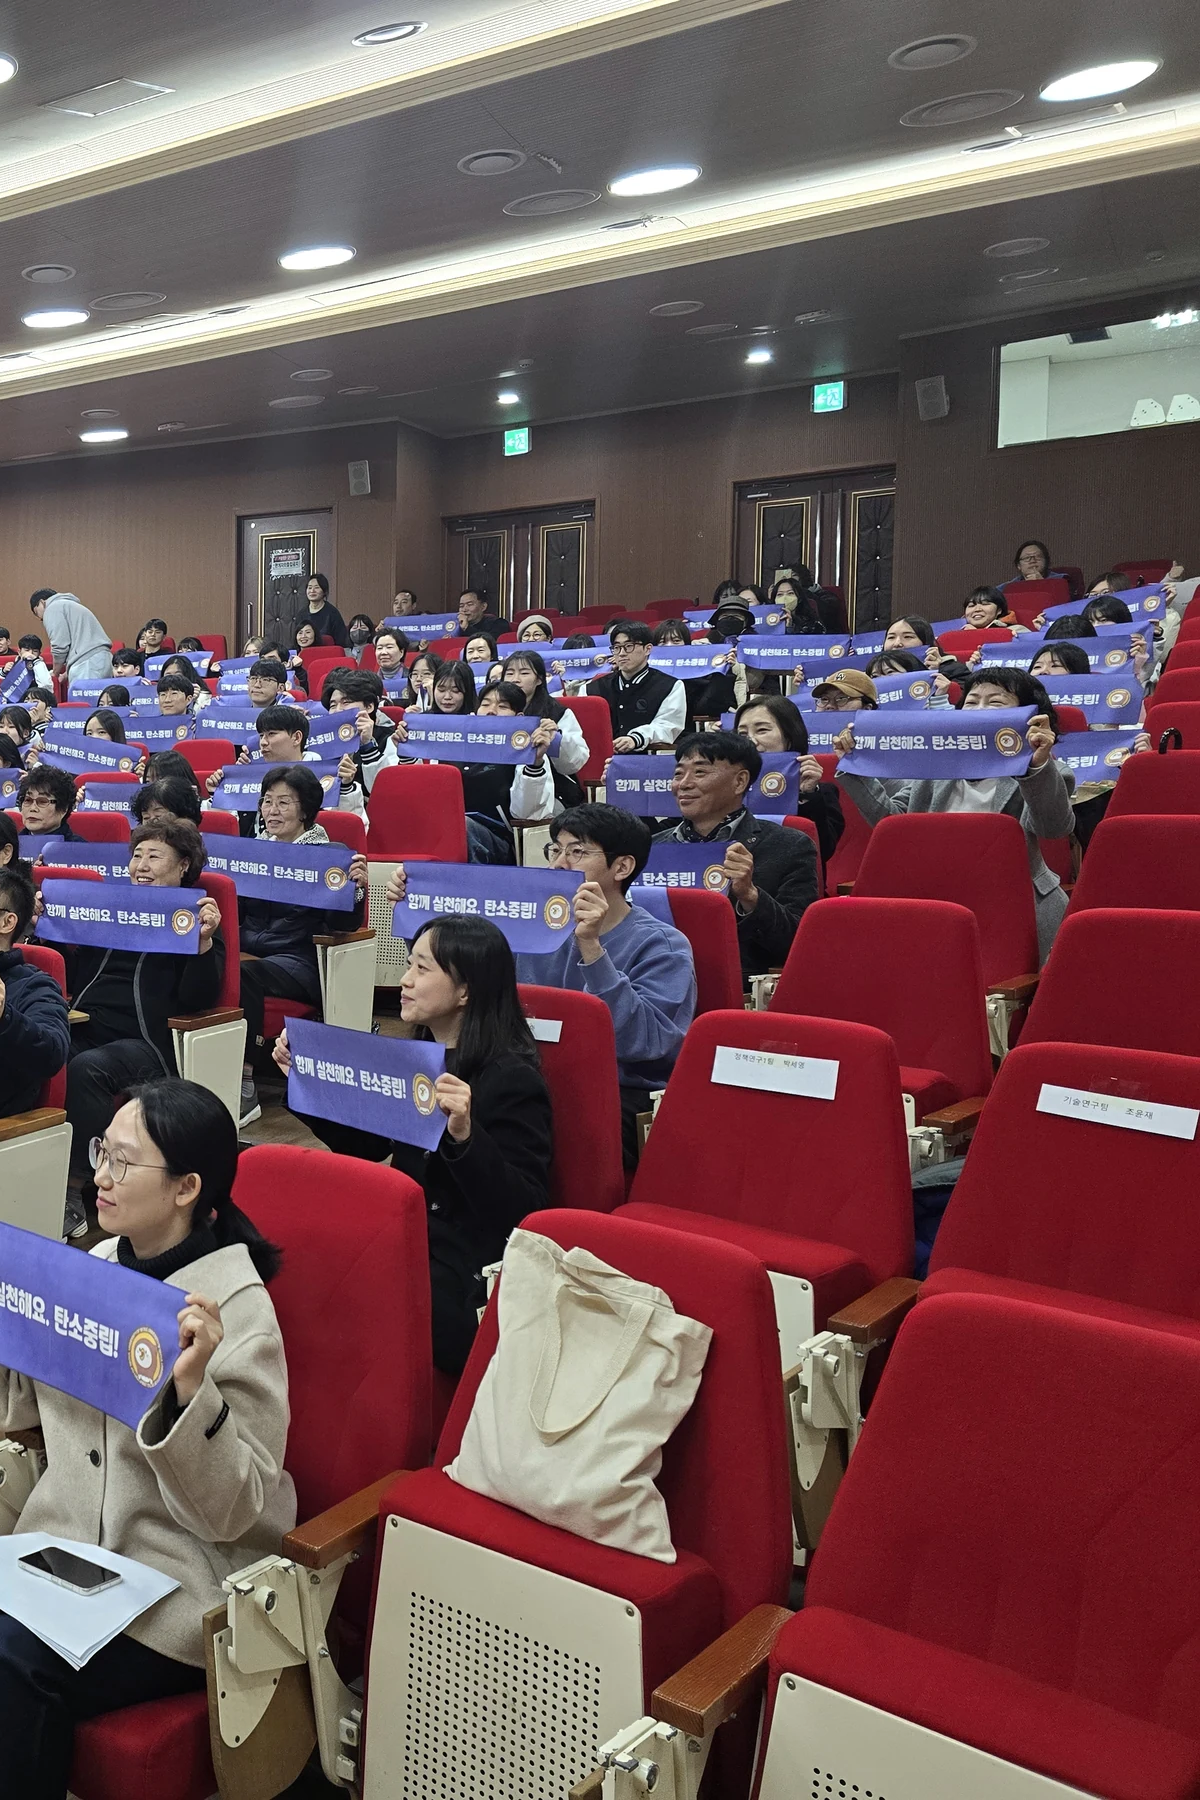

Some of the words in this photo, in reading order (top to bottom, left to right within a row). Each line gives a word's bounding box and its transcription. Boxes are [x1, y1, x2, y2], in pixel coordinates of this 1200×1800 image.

[421, 624, 442, 632] 탄소중립!
[793, 648, 825, 656] 탄소중립!
[857, 646, 872, 655] 함께
[676, 658, 708, 666] 탄소중립!
[807, 678, 824, 687] 함께
[202, 719, 216, 728] 함께
[217, 721, 245, 730] 실천해요.
[146, 730, 172, 739] 탄소중립!
[428, 731, 465, 742] 실천해요.
[467, 733, 506, 745] 탄소중립!
[855, 736, 875, 749] 함께
[879, 736, 928, 749] 실천해요.
[932, 735, 987, 750] 탄소중립!
[45, 743, 58, 752] 함께
[59, 747, 86, 759] 실천해요.
[88, 753, 116, 766] 탄소중립!
[224, 784, 240, 793] 함께
[615, 779, 640, 792] 함께
[102, 801, 131, 811] 실천해요.
[207, 856, 227, 870] 함께
[230, 860, 271, 876] 실천해요.
[274, 866, 318, 883] 탄소중립!
[643, 872, 695, 887] 탄소중립!
[408, 893, 430, 911] 함께
[433, 896, 480, 914] 실천해요.
[484, 900, 537, 919] 탄소중립!
[45, 904, 66, 918] 함께
[69, 907, 114, 922] 실천해요.
[117, 911, 165, 927] 탄소중립!
[295, 1054, 314, 1076] 함께
[316, 1060, 358, 1087] 실천해요.
[360, 1070, 406, 1099] 탄소중립!
[1063, 1096, 1109, 1111] 기술연구팀
[54, 1304, 120, 1358] 탄소중립!
